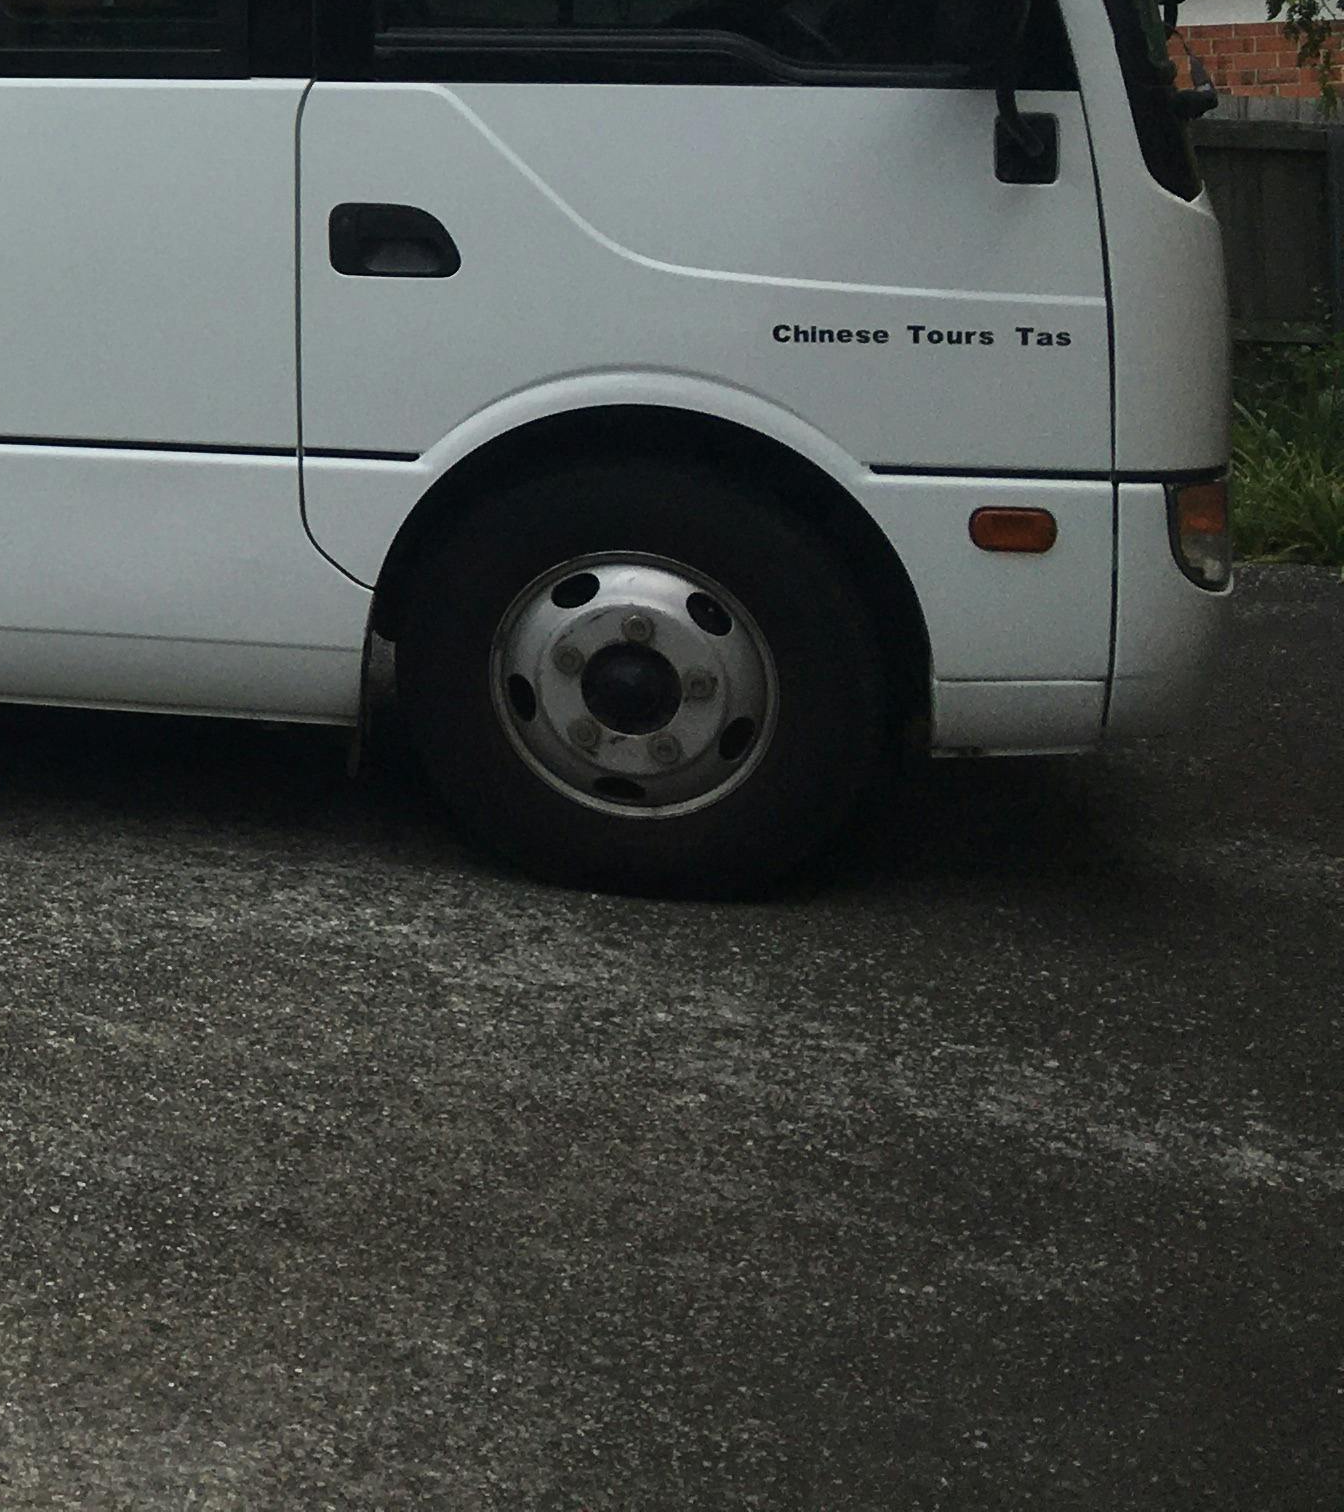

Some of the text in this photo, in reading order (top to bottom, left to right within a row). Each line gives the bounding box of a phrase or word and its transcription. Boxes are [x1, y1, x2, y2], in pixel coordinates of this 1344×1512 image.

[772, 324, 1072, 346] Chinese Tours Tas
